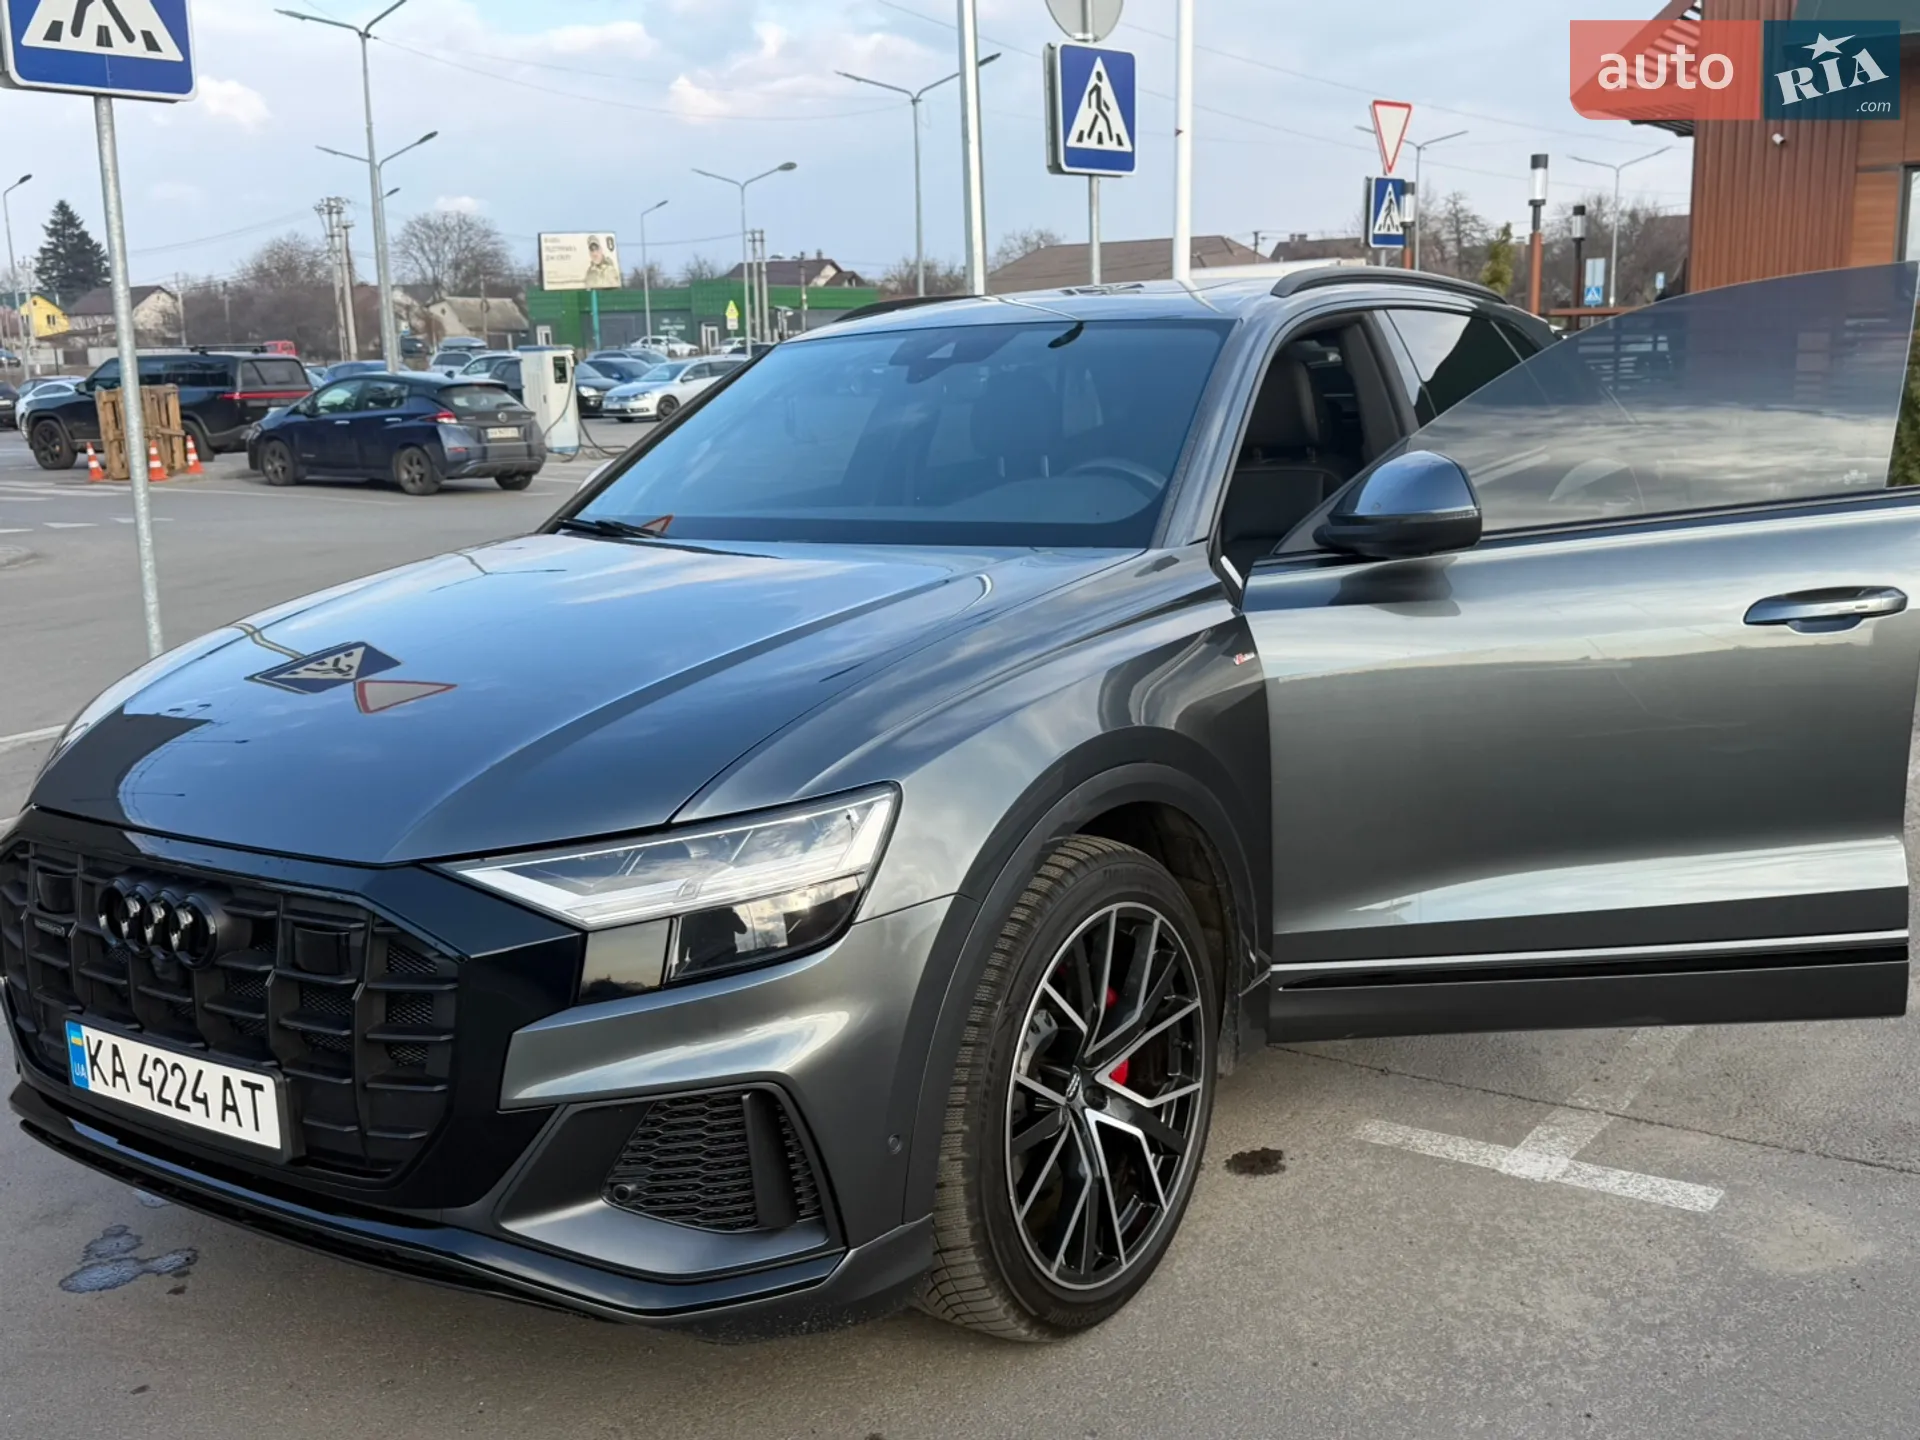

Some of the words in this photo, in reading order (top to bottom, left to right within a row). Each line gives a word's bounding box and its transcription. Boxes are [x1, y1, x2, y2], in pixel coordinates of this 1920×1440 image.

[74, 1062, 88, 1079] UA
[85, 1034, 131, 1093] KA
[138, 1053, 210, 1119] 4224
[221, 1075, 265, 1132] AT
